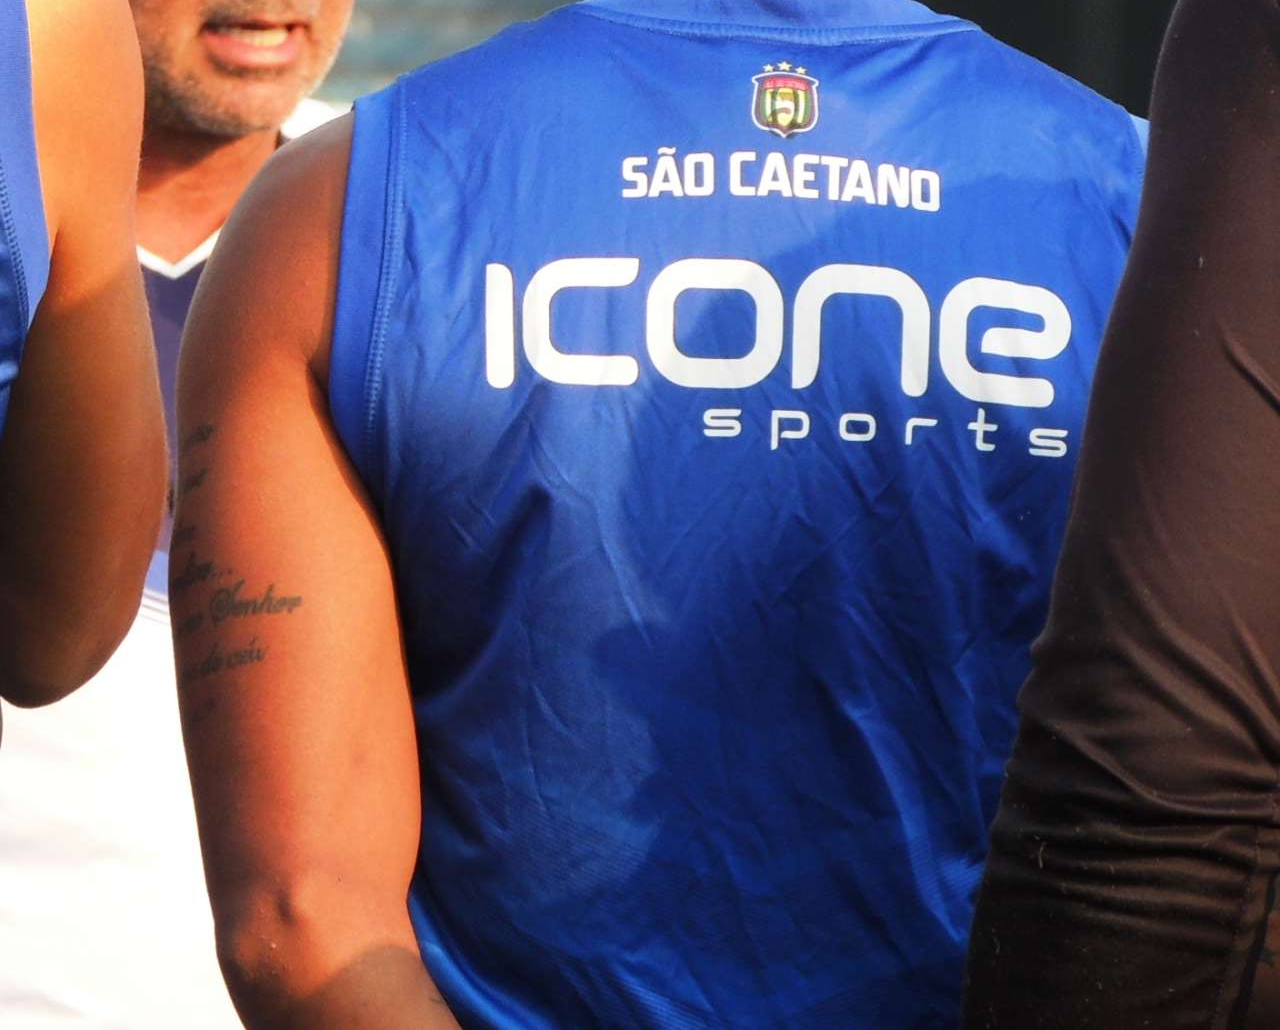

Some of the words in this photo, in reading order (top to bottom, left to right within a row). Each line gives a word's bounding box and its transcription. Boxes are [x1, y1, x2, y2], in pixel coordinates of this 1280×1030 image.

[622, 146, 716, 198] SÃO
[729, 151, 940, 212] CAETANO
[703, 408, 1068, 457] sports
